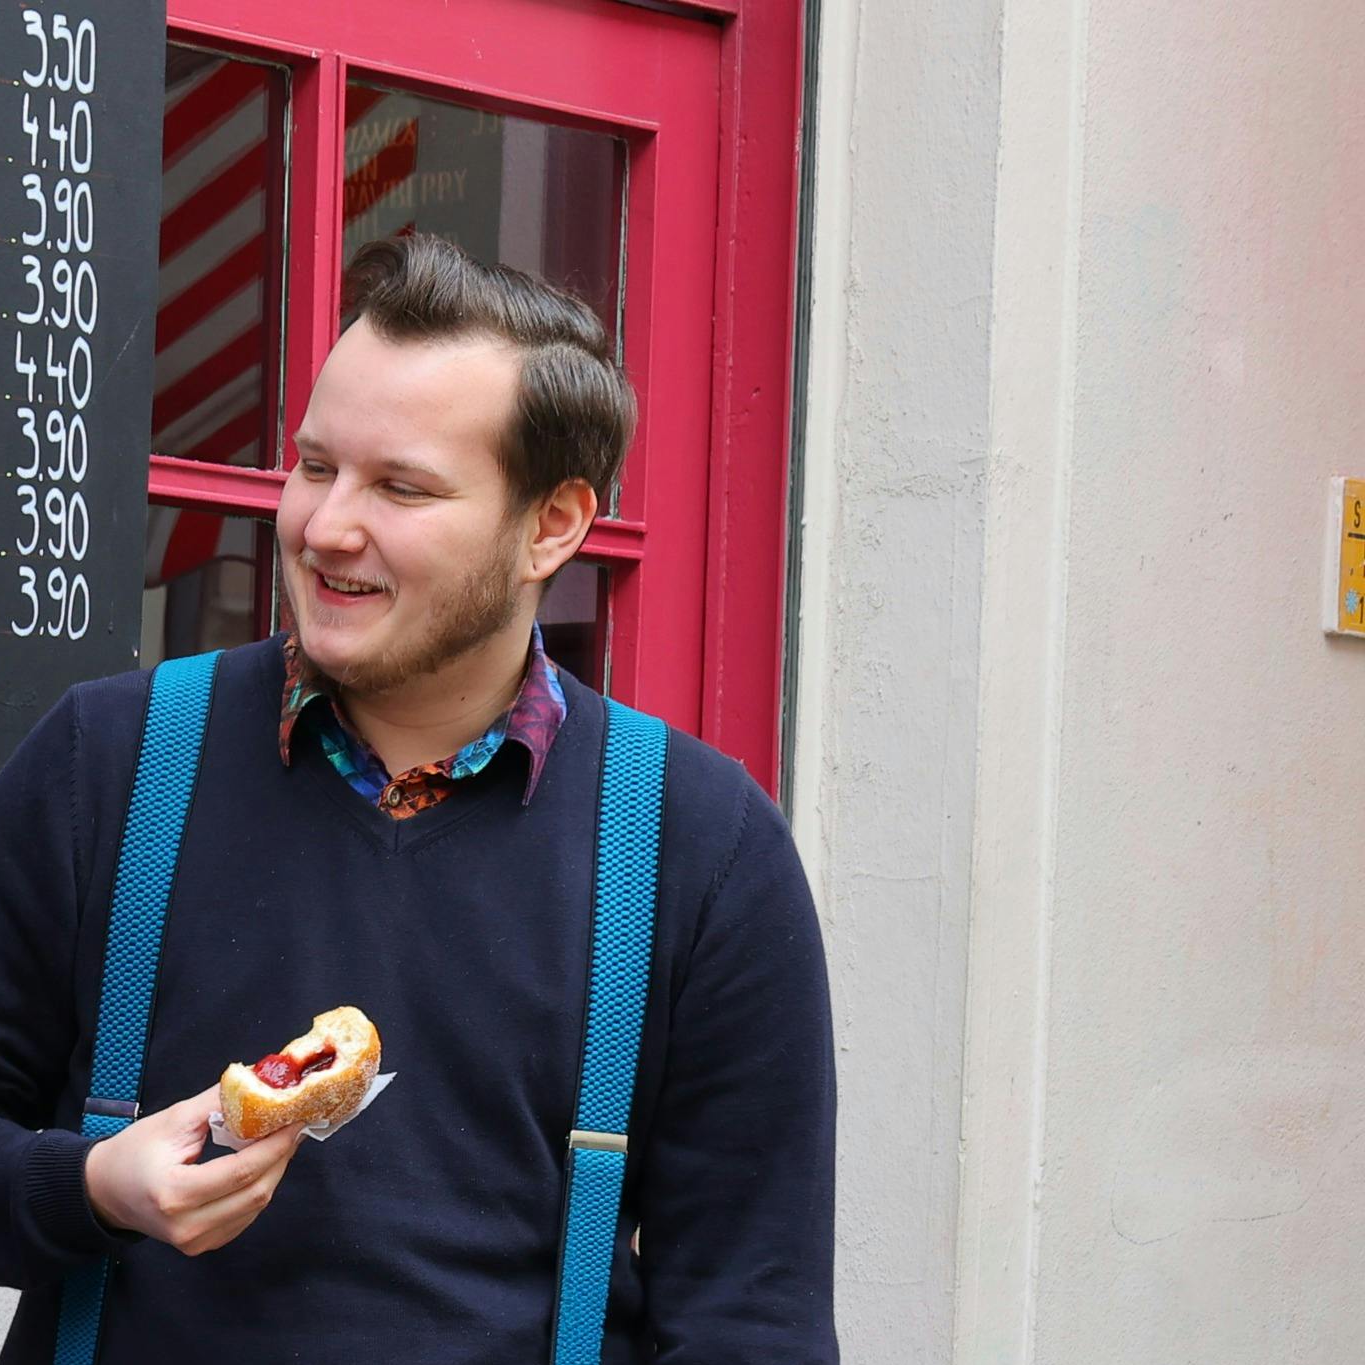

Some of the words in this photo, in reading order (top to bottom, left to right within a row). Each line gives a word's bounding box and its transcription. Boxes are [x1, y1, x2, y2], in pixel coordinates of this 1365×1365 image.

[22, 10, 96, 94] 3.50
[21, 92, 93, 174] 4.40
[21, 173, 94, 253] 3.90
[16, 254, 98, 335] 3.90
[15, 330, 92, 410] 4.40
[16, 407, 88, 483] 3.90
[16, 484, 89, 561] 3.90
[11, 566, 90, 640] 3.90
